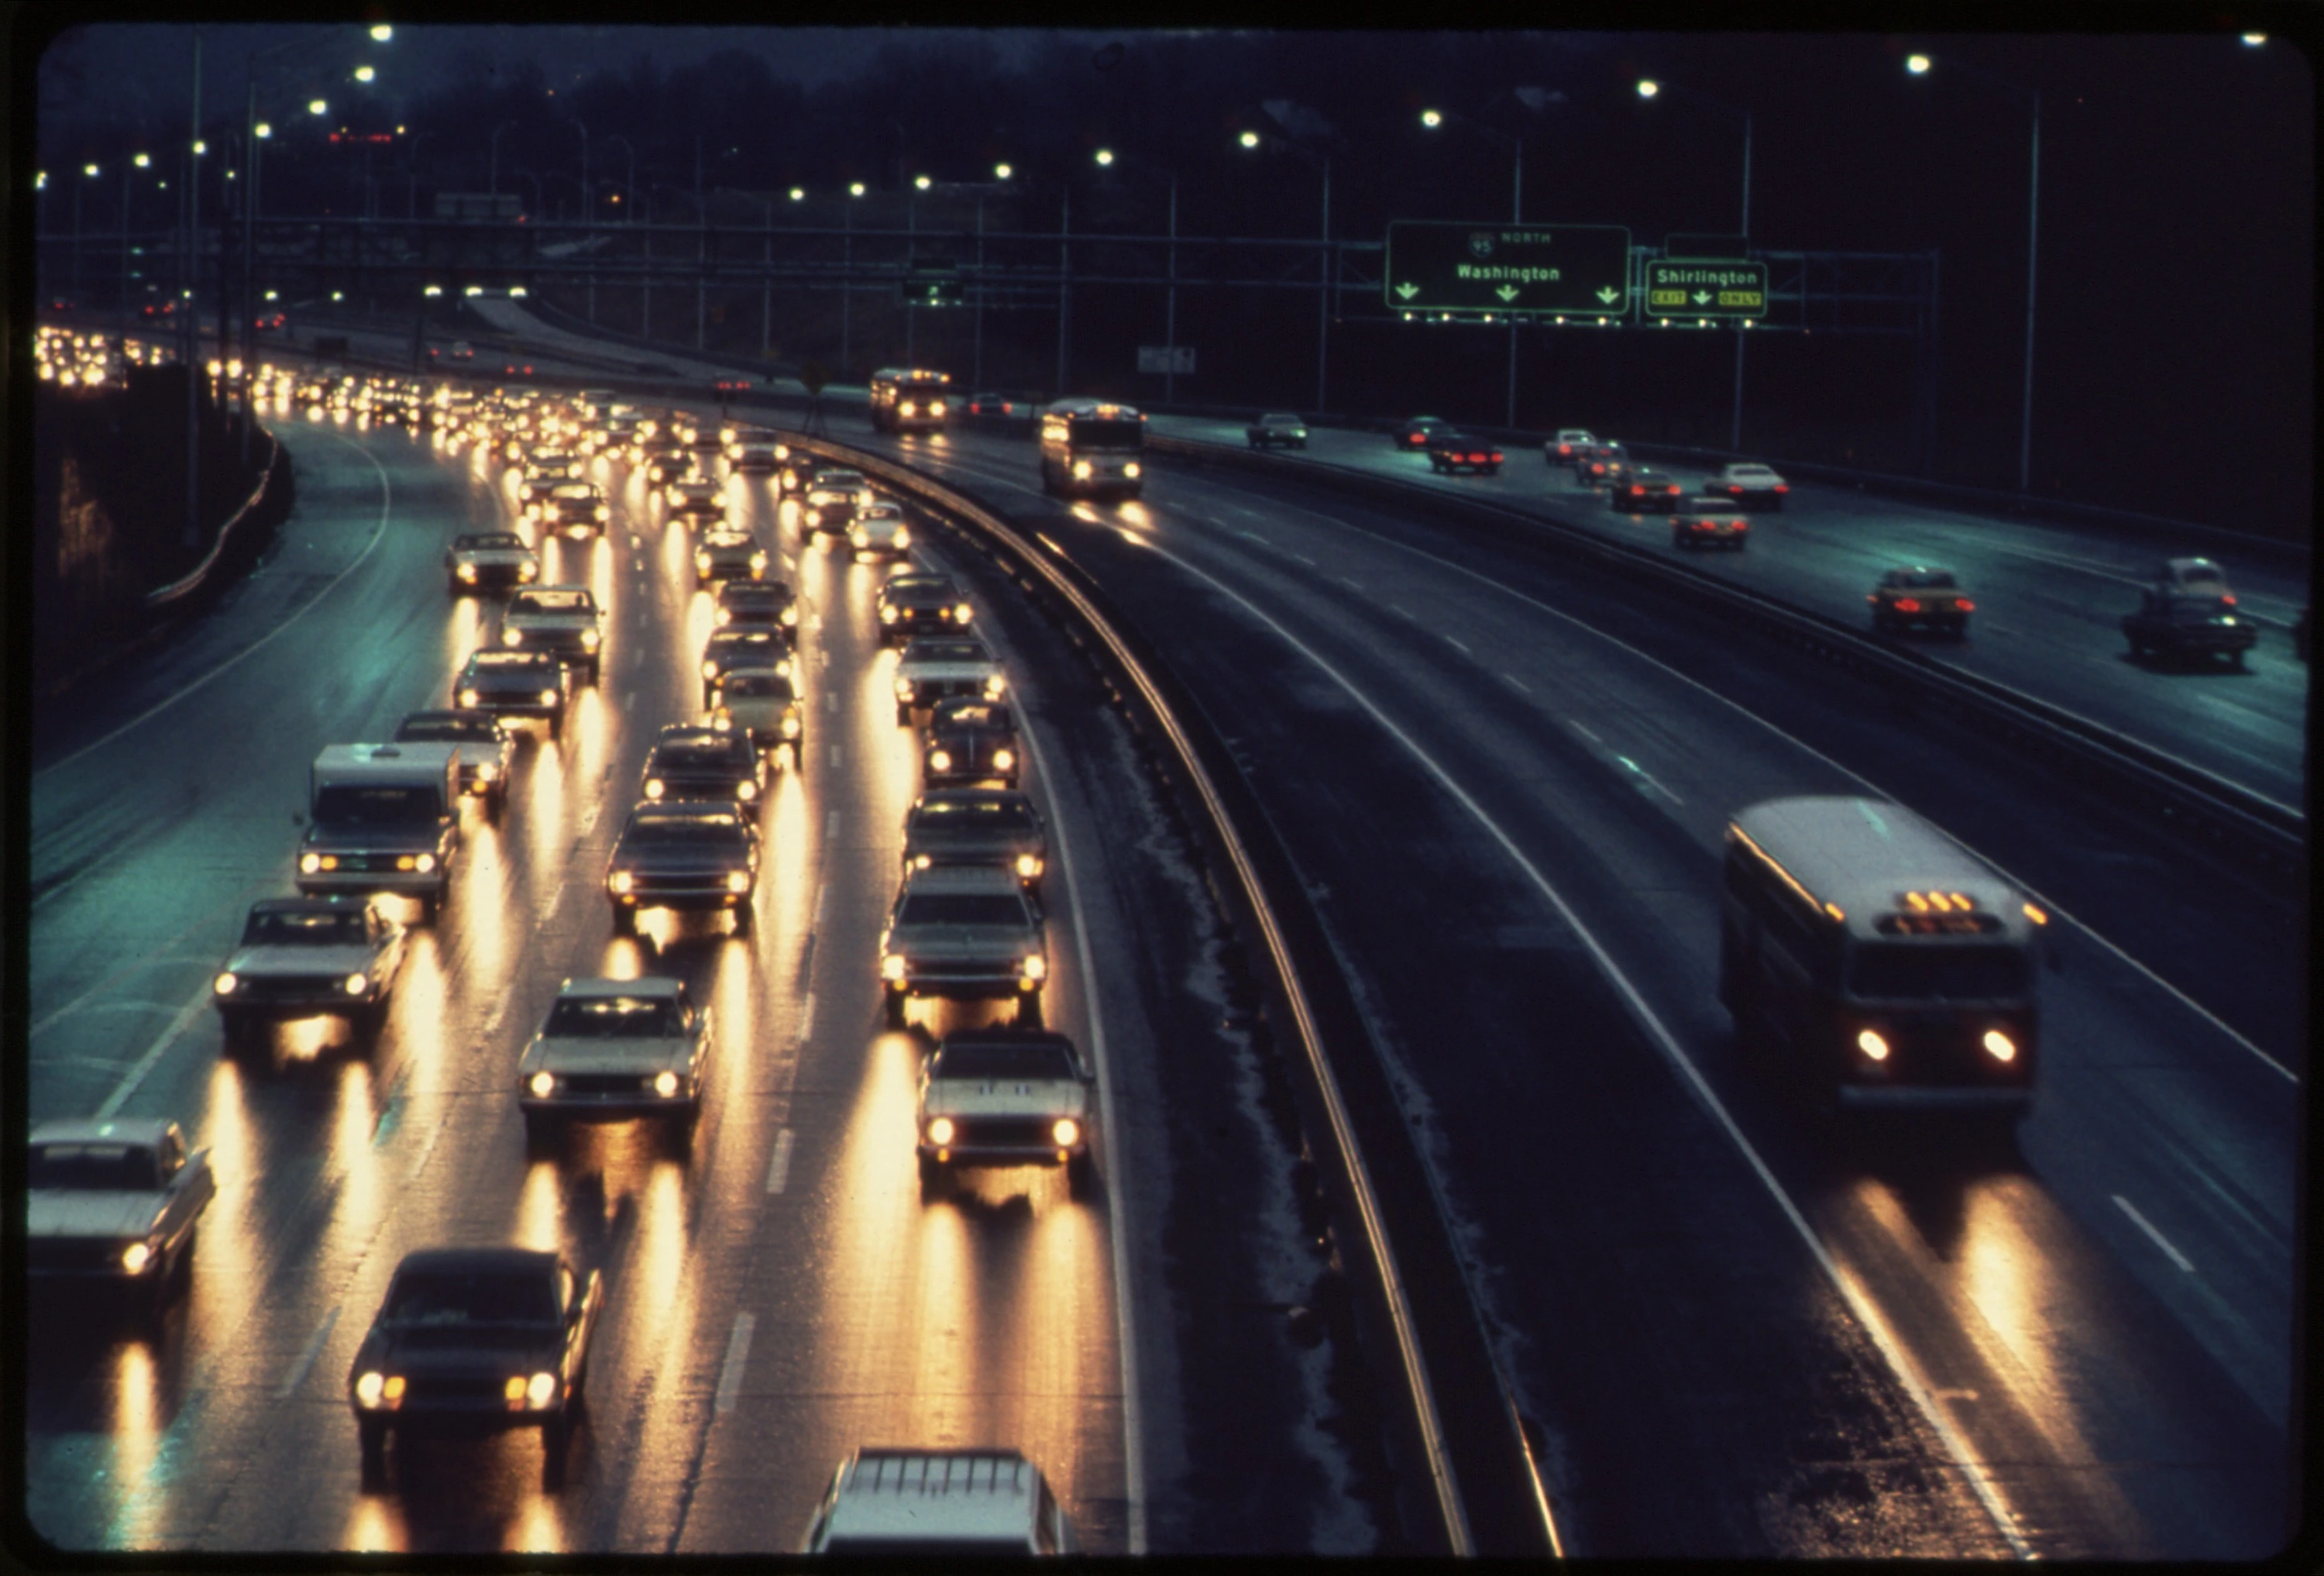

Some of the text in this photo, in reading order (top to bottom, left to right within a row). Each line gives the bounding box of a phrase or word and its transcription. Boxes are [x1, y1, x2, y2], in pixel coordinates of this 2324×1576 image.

[1473, 232, 1551, 252] 95 NORTH
[1458, 263, 1560, 284] Washington
[1657, 269, 1757, 287] Shirlington
[1653, 291, 1760, 305] EXIT ONLY
